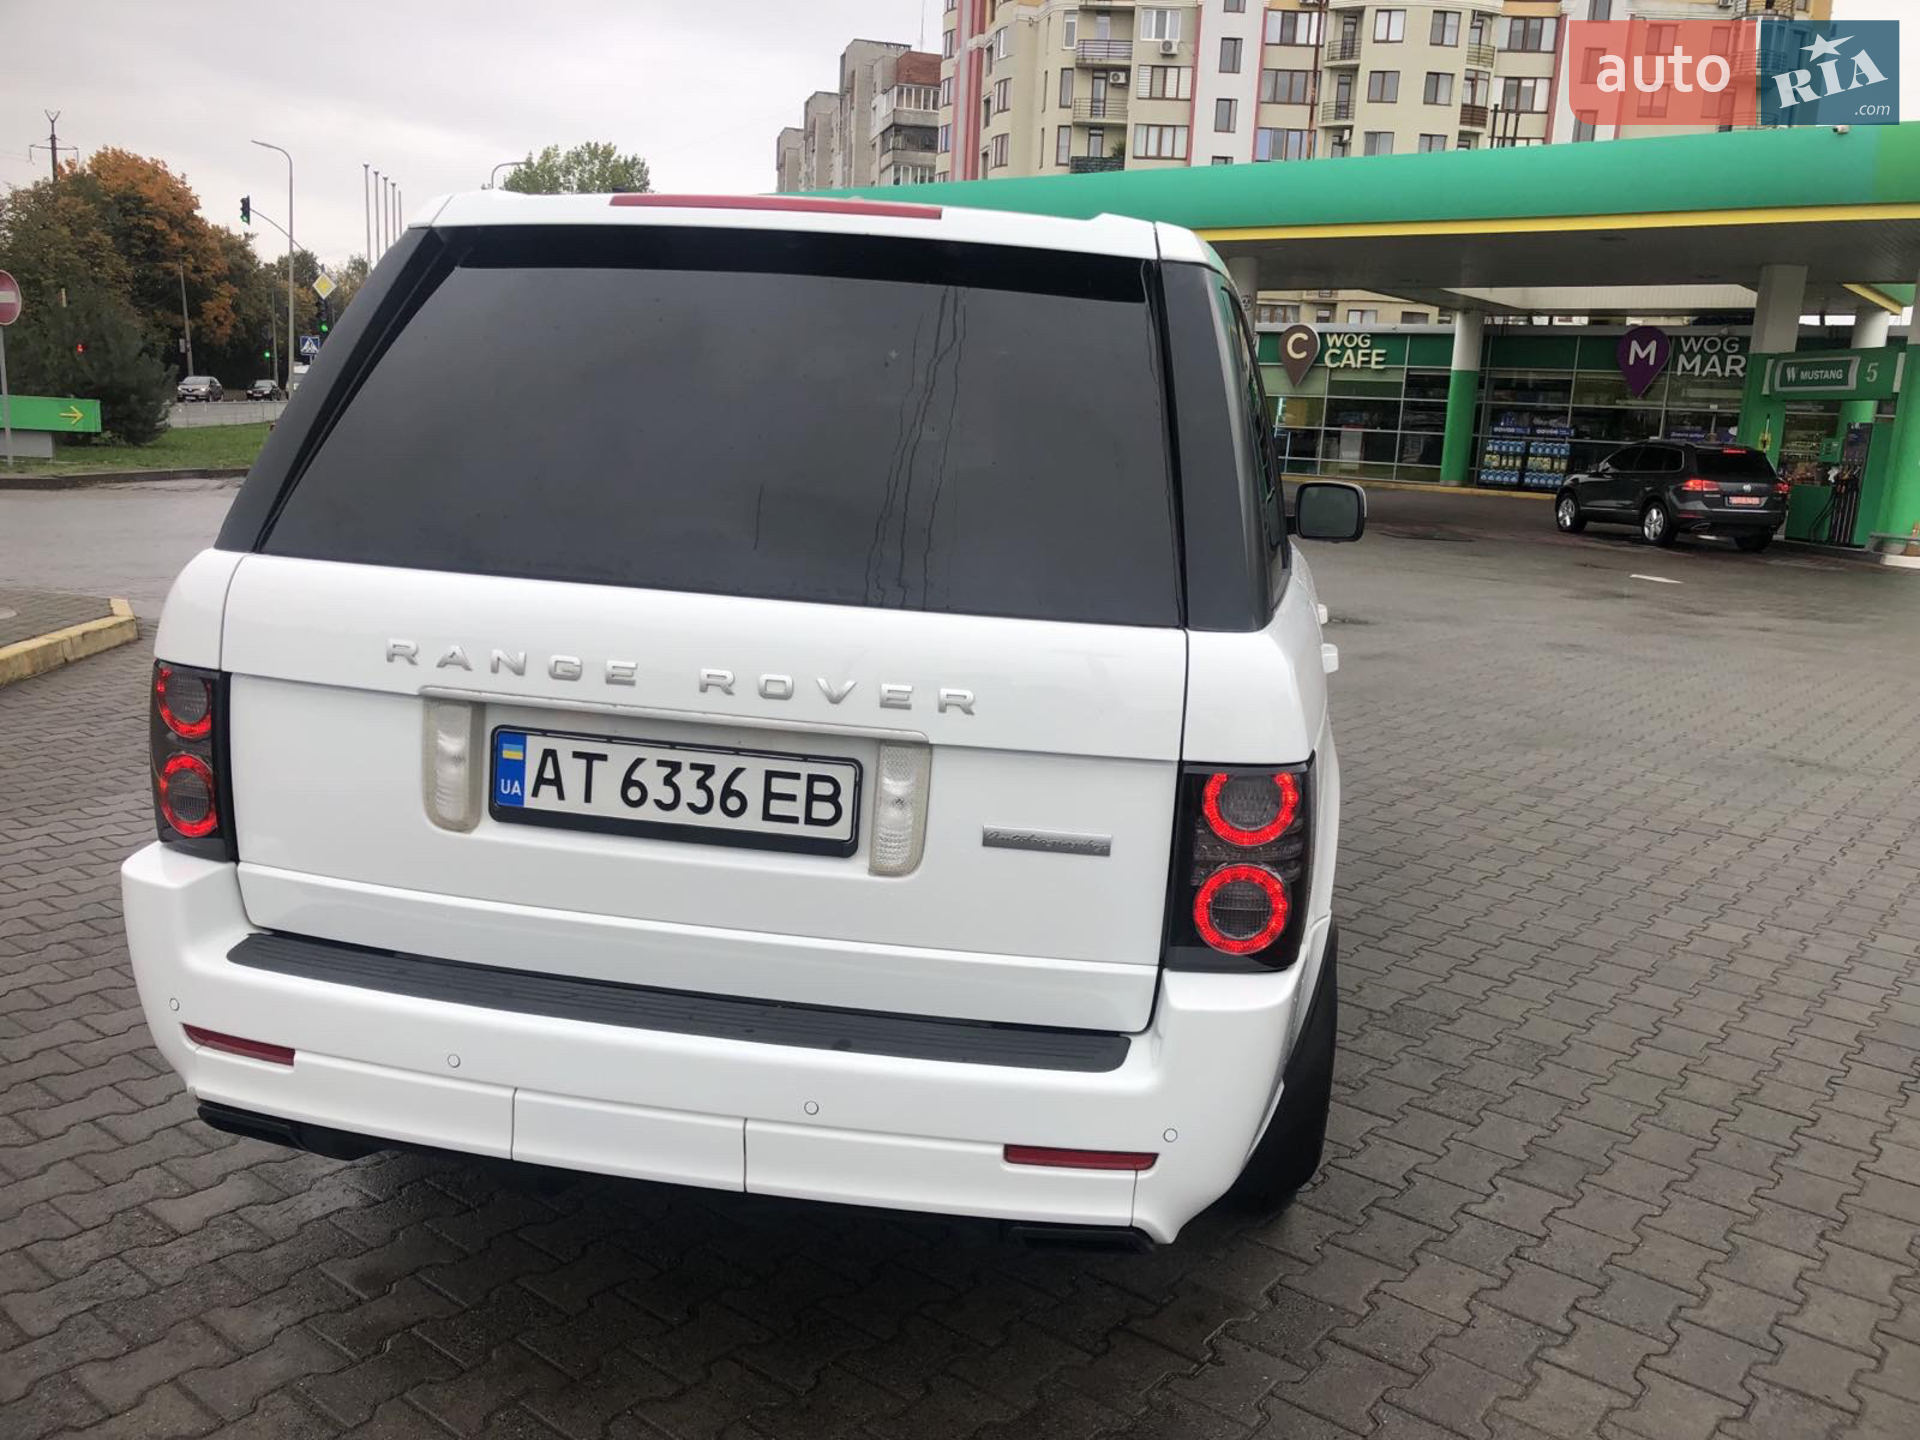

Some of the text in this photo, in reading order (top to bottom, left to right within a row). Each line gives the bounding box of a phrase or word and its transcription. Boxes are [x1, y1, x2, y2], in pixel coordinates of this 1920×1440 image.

[1286, 332, 1309, 360] C
[1325, 333, 1372, 348] WOG
[1680, 336, 1740, 353] WOG
[1324, 348, 1387, 370] CAFE
[1628, 339, 1657, 366] M
[1799, 367, 1844, 381] MUSTANG
[1865, 362, 1879, 383] 5
[386, 638, 976, 716] RANGE ROVER
[500, 778, 522, 797] UA
